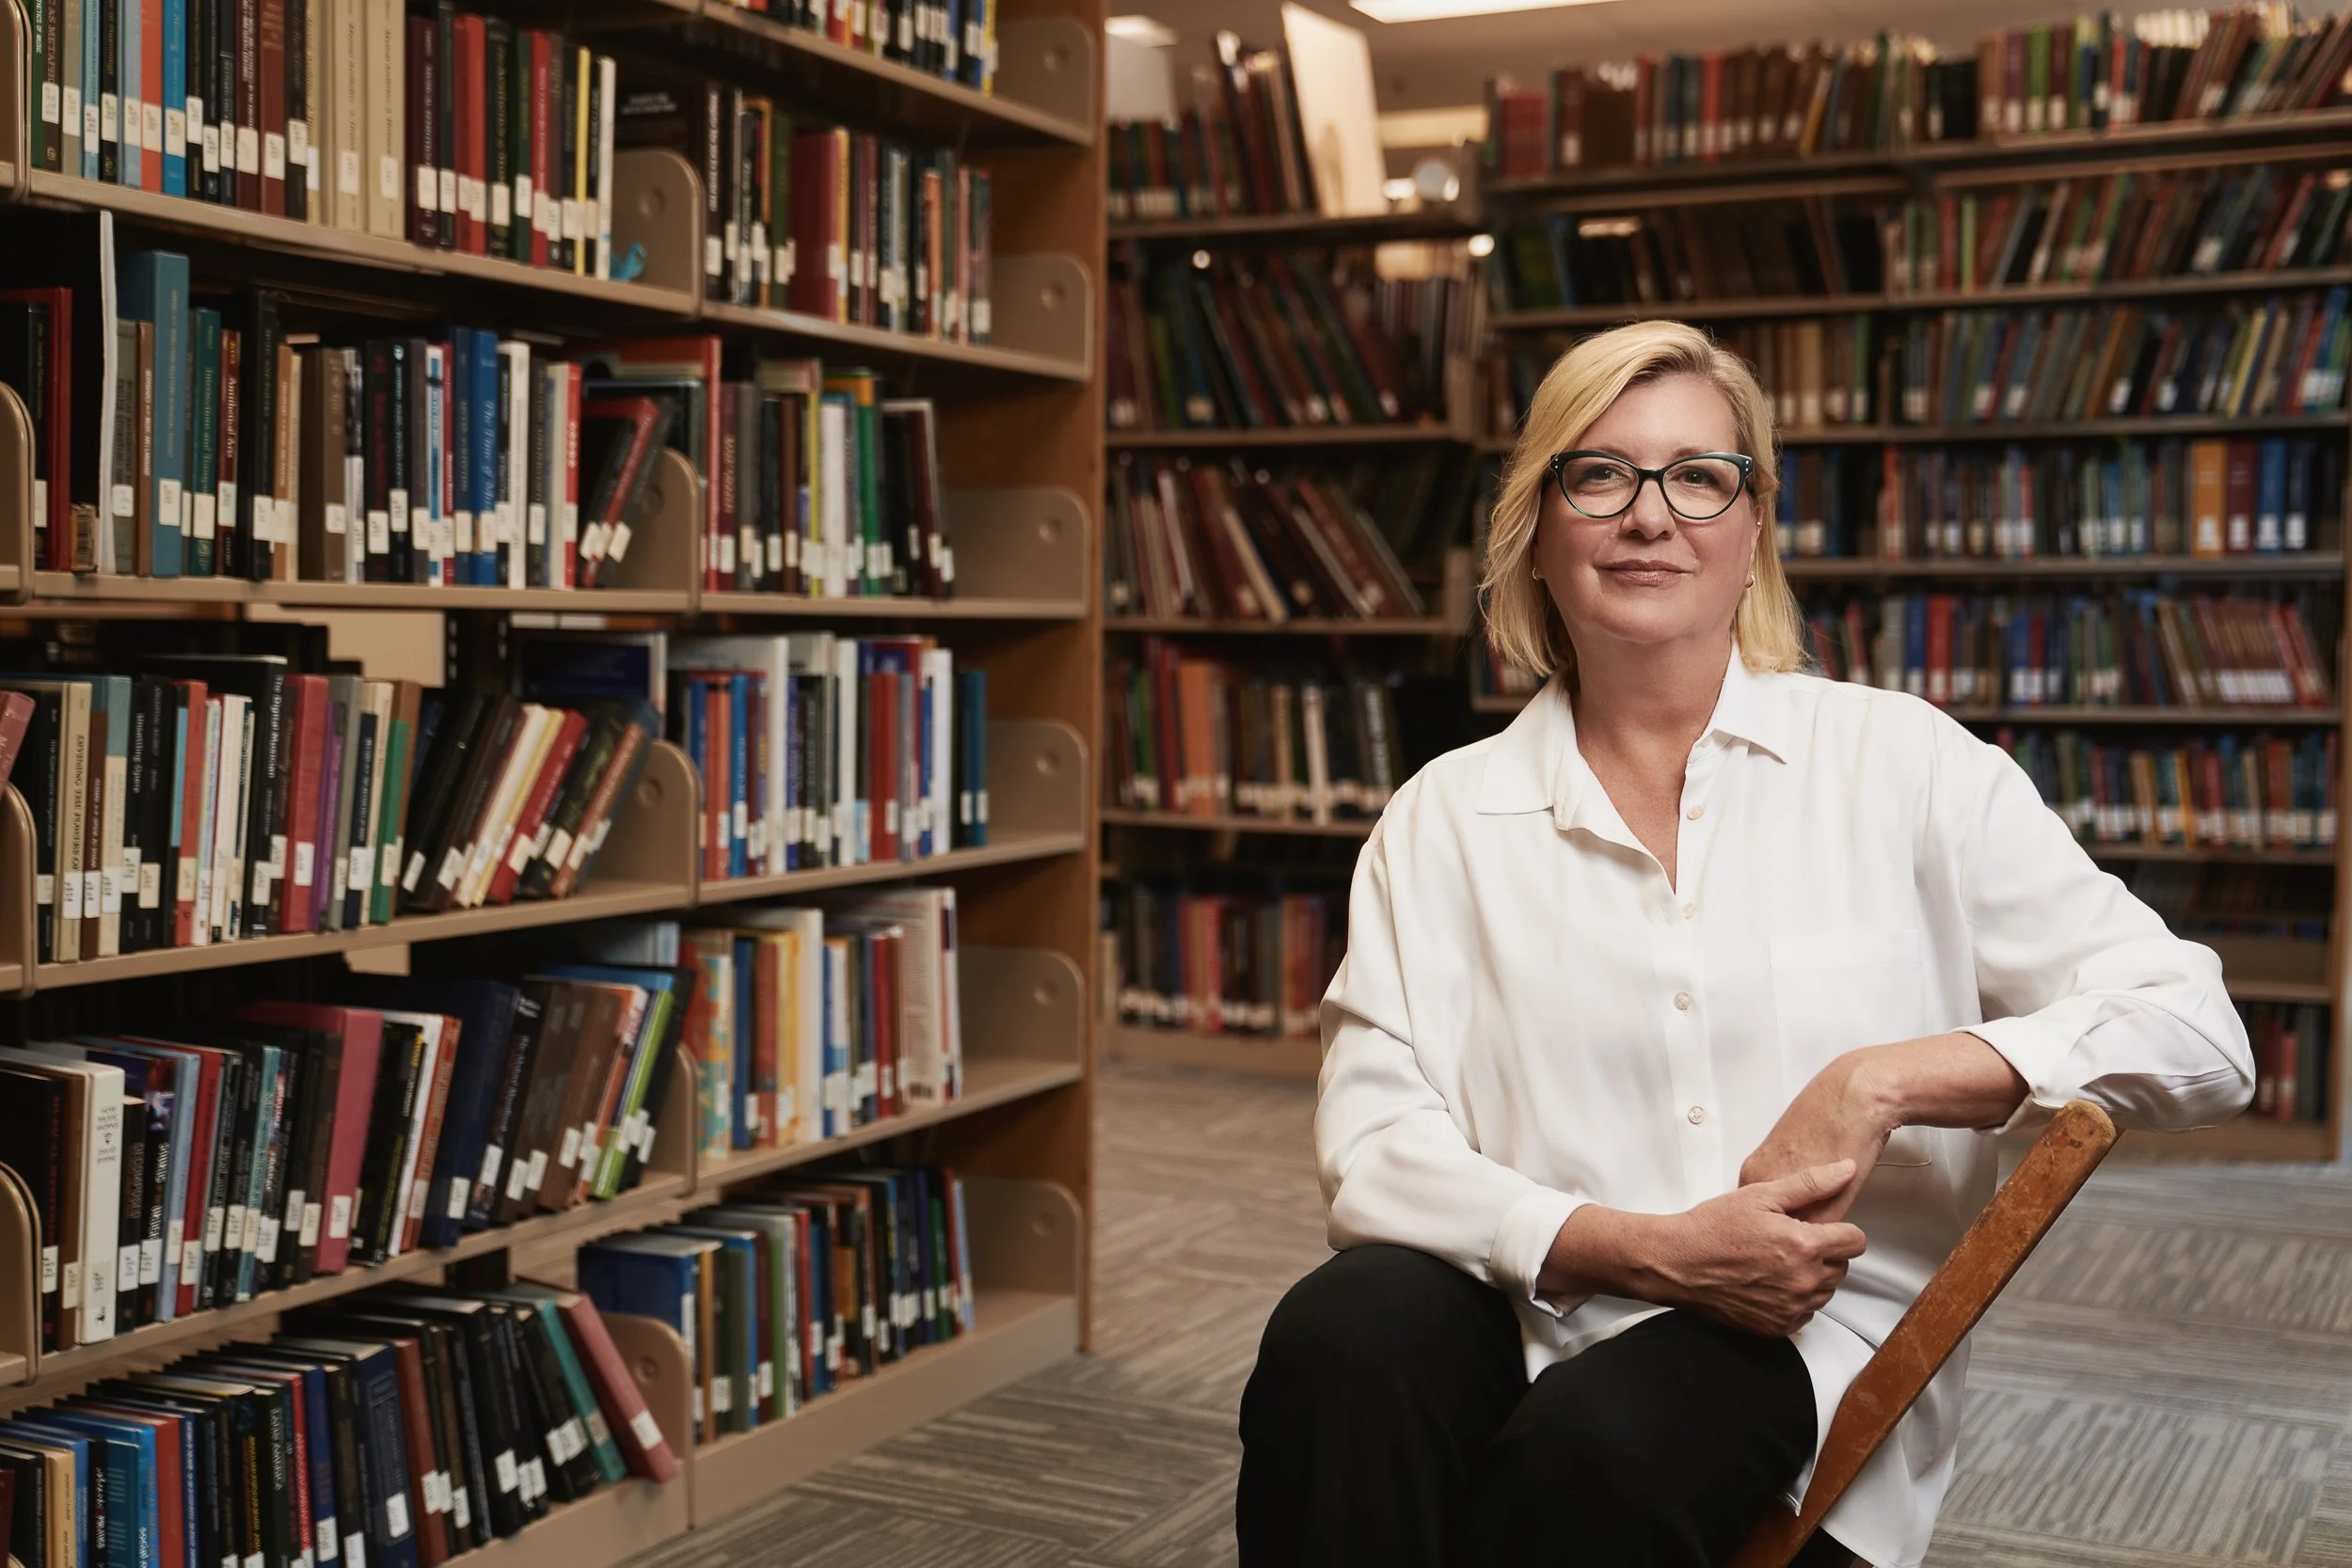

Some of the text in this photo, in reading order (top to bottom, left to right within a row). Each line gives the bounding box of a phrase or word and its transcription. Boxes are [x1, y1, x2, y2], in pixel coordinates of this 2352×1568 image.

[134, 712, 145, 763] Unsettling
[268, 675, 284, 779] The Digital Musician
[75, 735, 85, 786] DIVINING
[133, 764, 143, 794] Opera
[74, 789, 83, 809] THE
[72, 812, 82, 856] POWERS
[500, 1087, 517, 1132] Handbook
[130, 1142, 144, 1220] DECOMPOSED
[148, 1205, 163, 1240] UNDER
[270, 1407, 282, 1492] LATIN AMERICA
[138, 1527, 150, 1560] social
